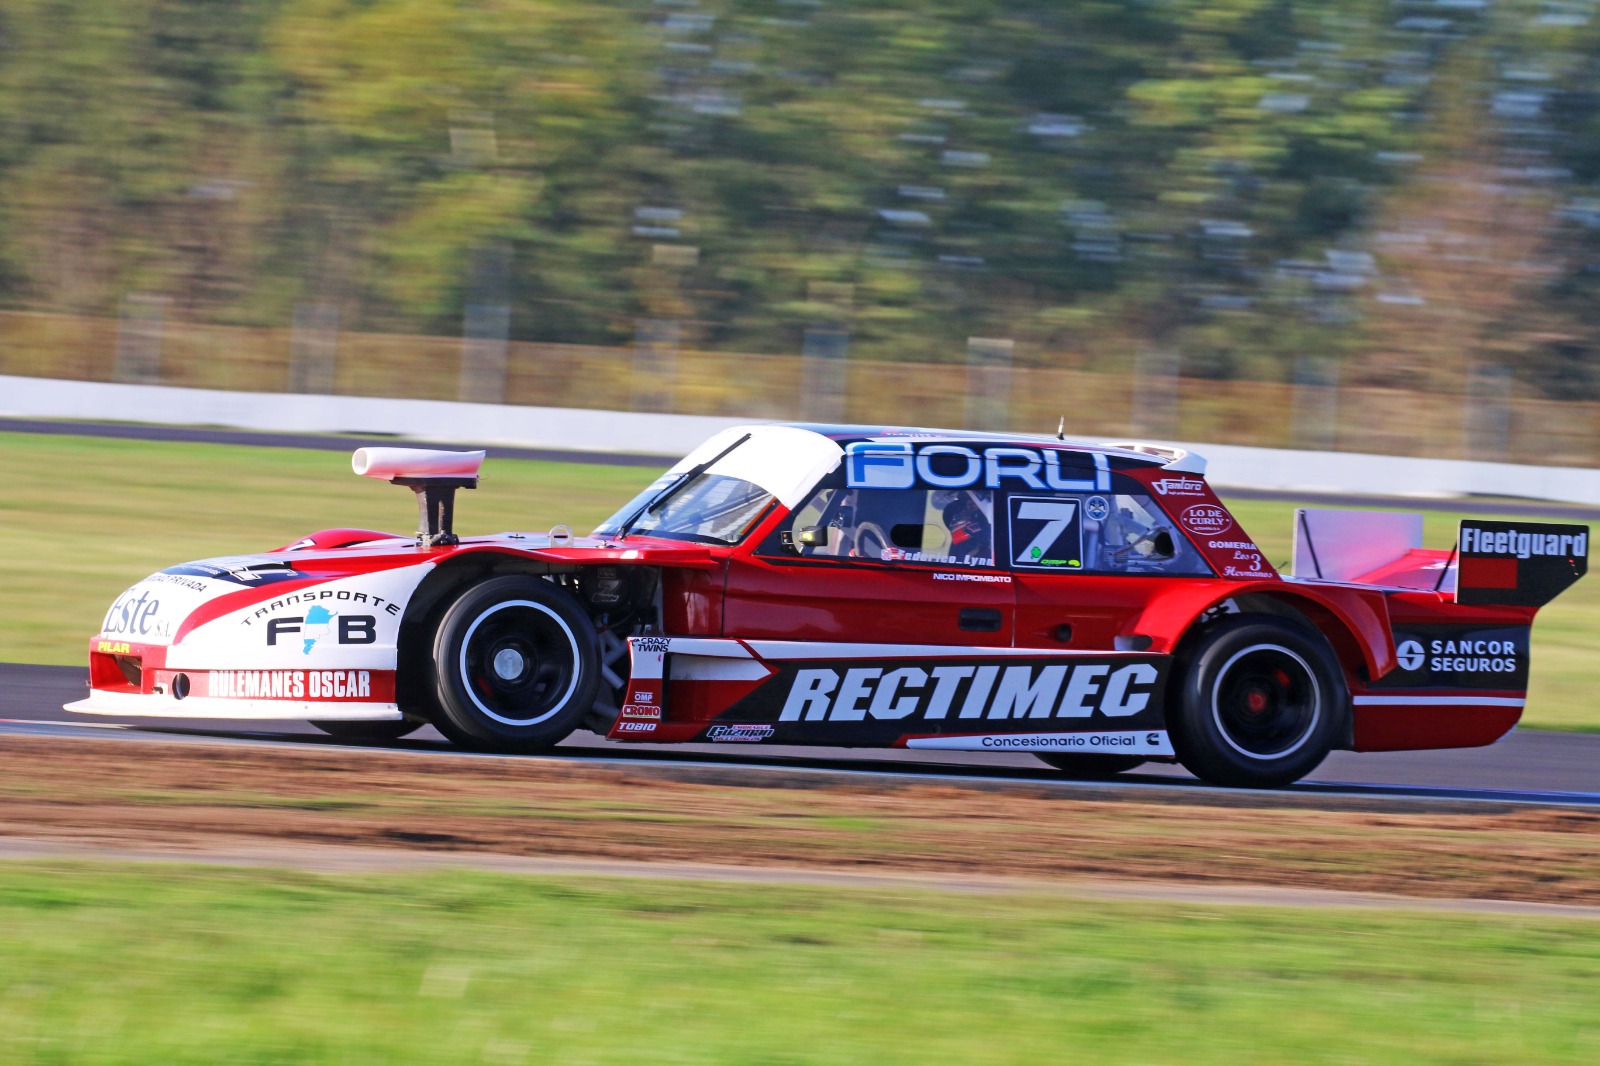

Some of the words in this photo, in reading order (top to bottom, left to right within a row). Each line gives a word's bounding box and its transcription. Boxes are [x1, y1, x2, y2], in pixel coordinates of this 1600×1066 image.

[845, 442, 1112, 492] FORLI
[1208, 510, 1223, 518] DE
[1189, 517, 1224, 525] CURLY
[1015, 501, 1076, 563] 7
[1208, 540, 1257, 550] GOMERIA
[1461, 528, 1588, 559] Fleetguard
[1249, 553, 1261, 571] 3
[955, 574, 1011, 583] IMPIOMBATO
[103, 588, 160, 635] Este
[241, 590, 400, 626] TRANSPORTE
[266, 616, 304, 646] F
[338, 614, 376, 645] B
[97, 641, 130, 653] PILAR
[641, 637, 671, 645] CRAZY
[1431, 640, 1516, 655] SANCOR
[638, 644, 669, 653] TWINS
[1431, 657, 1516, 673] SEGUROS
[208, 670, 305, 698] RULEMANES
[308, 671, 371, 698] OSCAR
[634, 693, 653, 702] OMP
[778, 663, 1159, 722] RECTIMEC
[623, 705, 660, 717] CRONO
[619, 722, 657, 731] TOBIO
[982, 737, 1085, 747] Concesionario
[1090, 735, 1136, 746] Oficial
